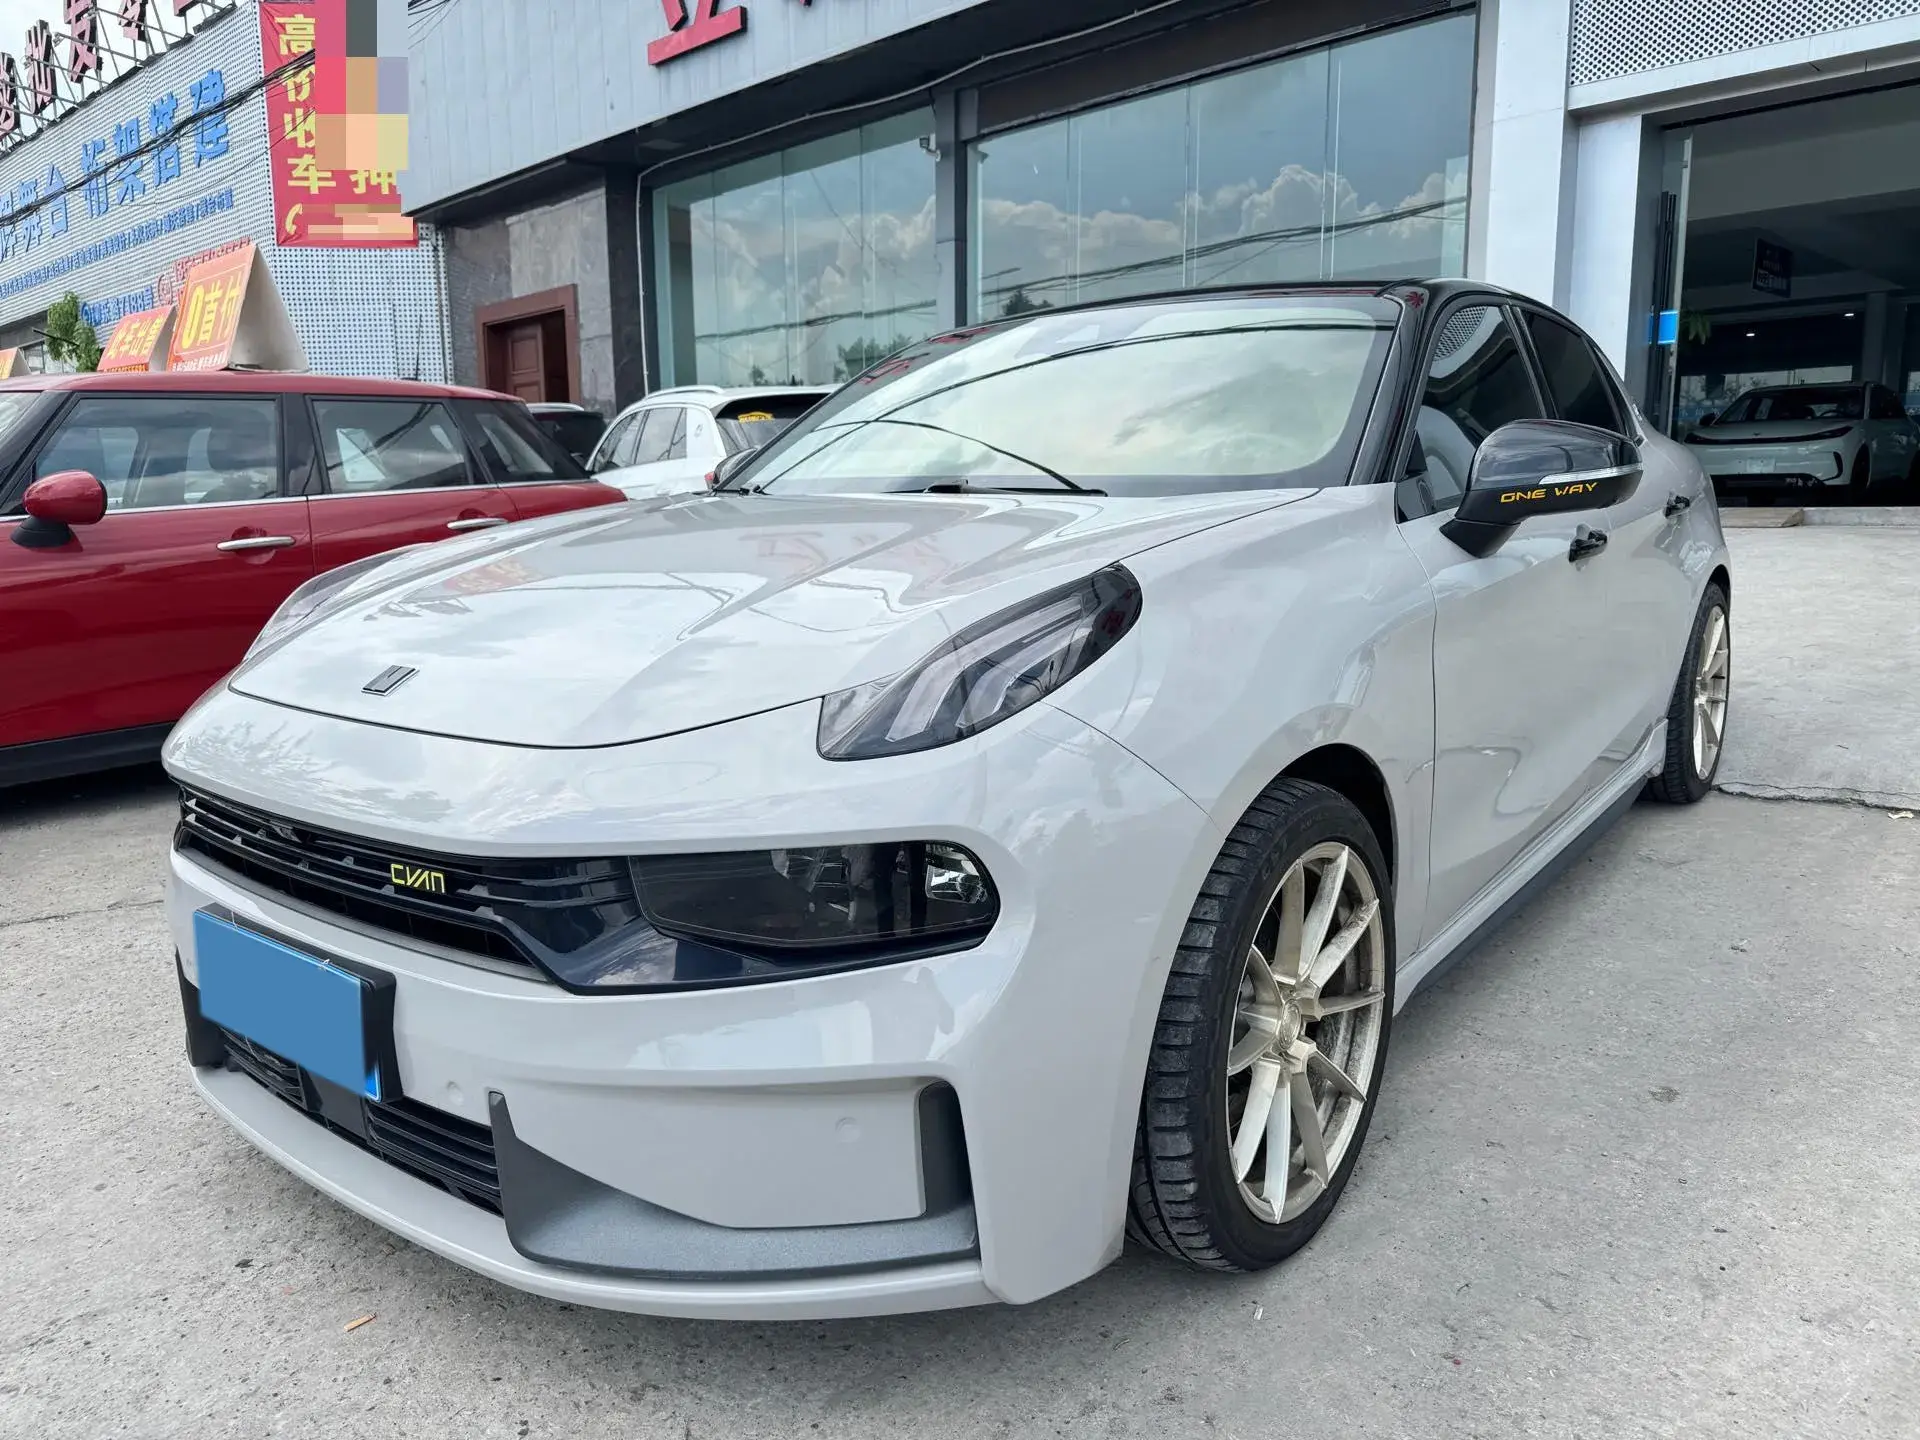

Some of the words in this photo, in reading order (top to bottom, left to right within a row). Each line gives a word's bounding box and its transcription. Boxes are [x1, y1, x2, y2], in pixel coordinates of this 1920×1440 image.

[1500, 488, 1547, 503] ONE
[1554, 481, 1599, 497] WAY
[390, 863, 445, 893] CYAN
